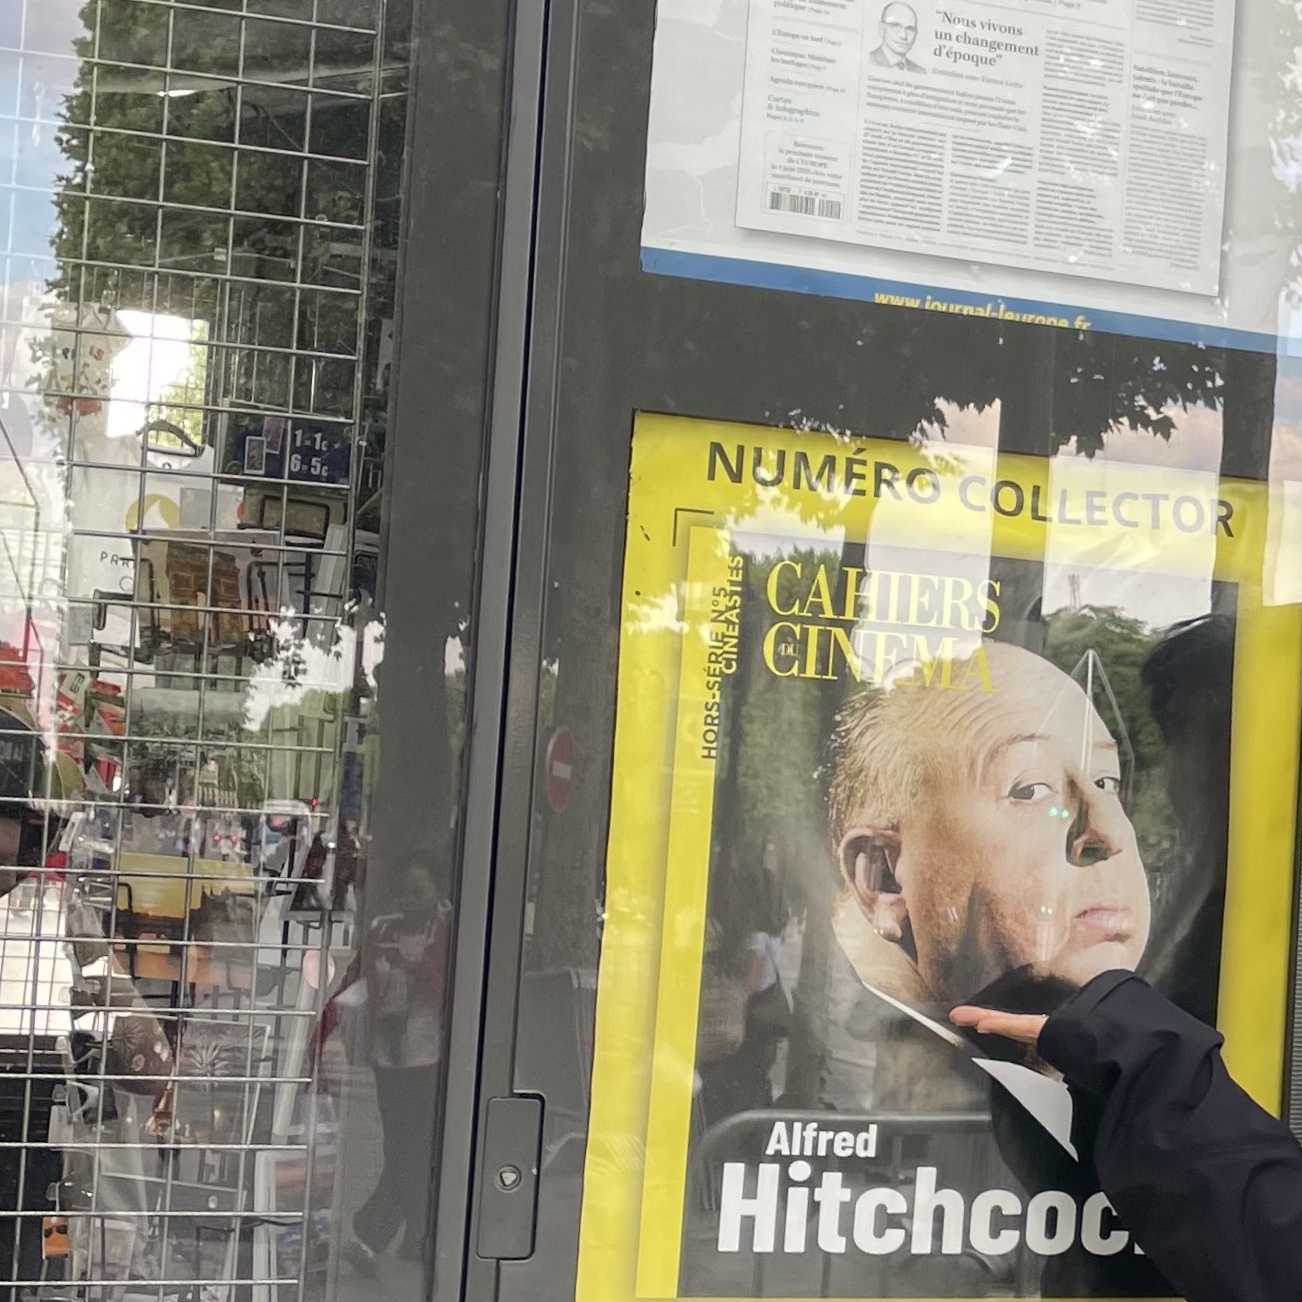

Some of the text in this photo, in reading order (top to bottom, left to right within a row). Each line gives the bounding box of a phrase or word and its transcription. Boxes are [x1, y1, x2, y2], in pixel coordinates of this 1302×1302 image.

[934, 29, 1040, 57] un changement
[935, 9, 1024, 37] "Nous vivons
[933, 44, 1004, 67] d'époque"
[706, 440, 1236, 539] NUMÉRO COLLECTOR
[766, 559, 1002, 635] CAHIERS
[701, 586, 728, 760] HORS-SÉRIE N°5
[765, 1120, 879, 1158] Alfred
[717, 1159, 1146, 1257] Hitchcoc
